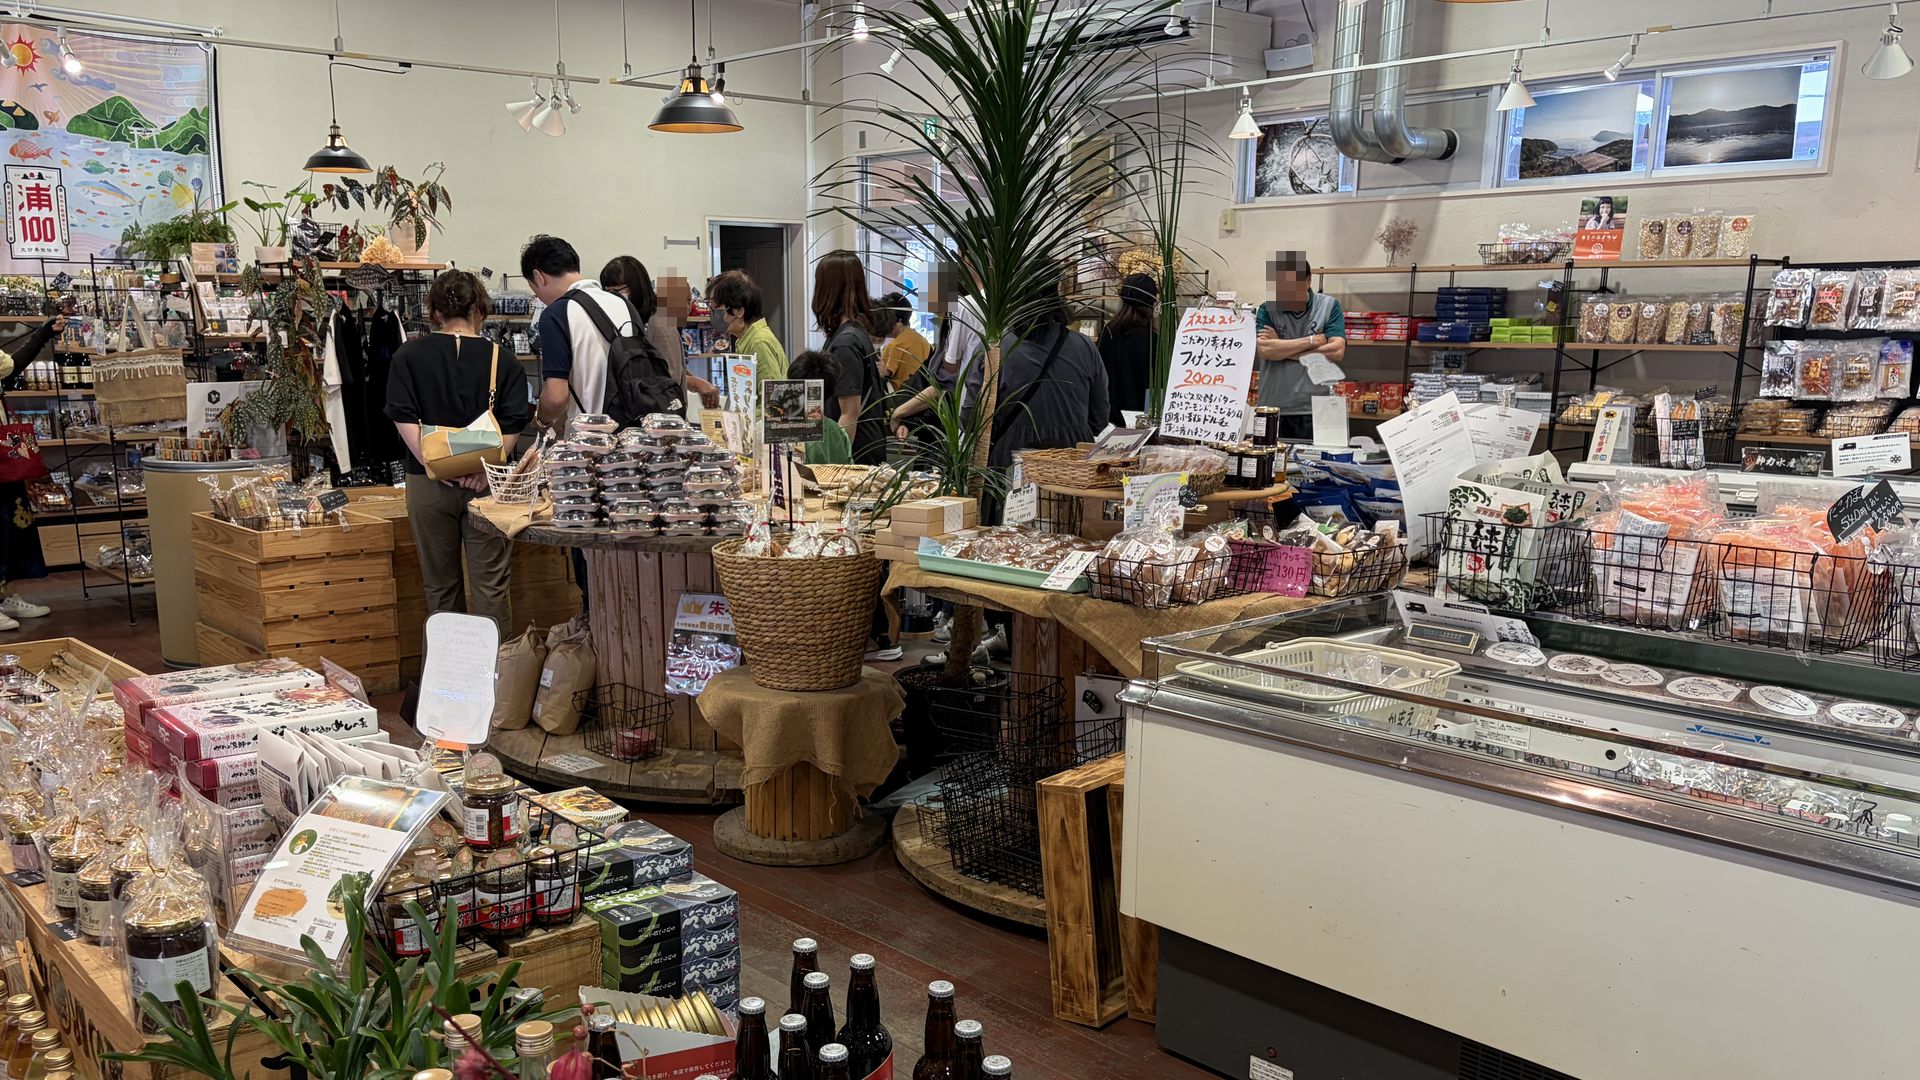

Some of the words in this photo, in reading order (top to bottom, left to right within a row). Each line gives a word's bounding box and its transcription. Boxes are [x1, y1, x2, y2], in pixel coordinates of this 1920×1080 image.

[17, 183, 53, 212] 浦
[19, 216, 56, 243] 100
[1183, 369, 1225, 385] 200円
[1755, 455, 1797, 469] 神力水産
